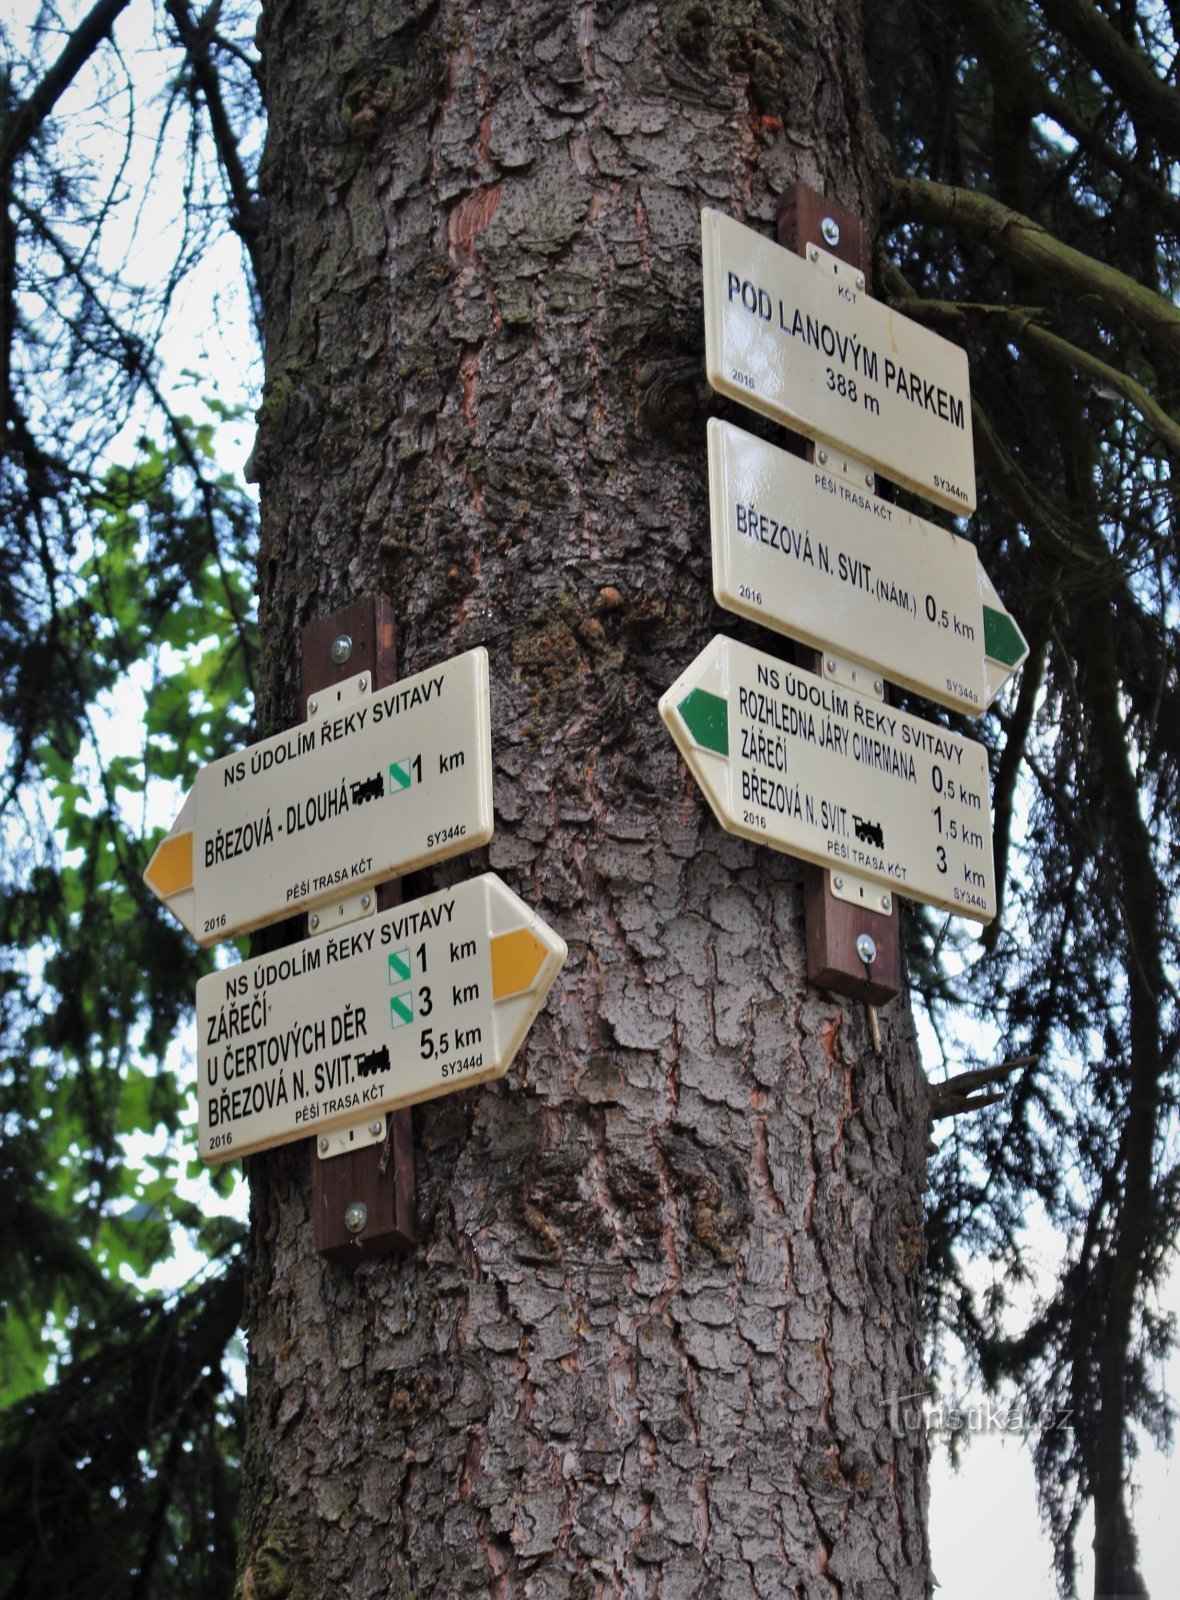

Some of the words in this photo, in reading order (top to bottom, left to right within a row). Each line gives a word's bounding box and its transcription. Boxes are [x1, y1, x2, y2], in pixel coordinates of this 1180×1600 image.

[838, 285, 857, 304] KČT
[727, 271, 772, 321] POD
[779, 300, 878, 382] LANOVÝM
[884, 358, 964, 429] PARKEM
[732, 370, 755, 389] 2016
[826, 368, 857, 403] 388
[864, 393, 880, 415] m
[815, 474, 837, 494] PĚŠÍ
[838, 485, 871, 512] TRASA
[873, 503, 892, 522] KČT
[933, 474, 968, 501] SY344m
[736, 504, 814, 566] BŘEZOVÁ
[818, 543, 833, 575] N.
[925, 595, 949, 628] 0,5
[953, 615, 974, 640] km
[739, 584, 762, 604] 2016
[946, 679, 978, 703] SY344a
[224, 762, 246, 787] NS
[251, 732, 316, 775] ÚDOLÍM
[320, 710, 368, 747] ŘEKY
[372, 675, 445, 723] SVITAVY
[758, 664, 779, 689] NS
[786, 672, 848, 716] ÚDOLÍM
[854, 700, 896, 737] ŘEKY
[901, 723, 963, 765] SVITAVY
[412, 754, 423, 784] 1
[439, 750, 465, 774] km
[739, 687, 815, 744] ROZHLEDNA
[819, 715, 849, 750] JÁRY
[853, 732, 916, 783] CIMRMANA
[932, 765, 955, 799] 0,5
[960, 785, 981, 808] km
[741, 726, 788, 773] ZÁŘEČÍ
[933, 806, 958, 839] 1,5
[962, 825, 984, 849] km
[427, 825, 466, 848] SY344c
[742, 770, 801, 824] BŘEZOVÁ
[806, 794, 818, 824] N.
[822, 801, 850, 838] SVIT.
[936, 846, 947, 873] 3
[964, 865, 986, 888] km
[743, 810, 766, 829] 2016
[286, 879, 311, 901] PĚŠÍ
[313, 869, 349, 893] TRASA
[351, 858, 373, 879] KČT
[827, 840, 850, 860] PĚŠÍ
[852, 849, 885, 872] TRASA
[888, 863, 907, 880] KČT
[954, 887, 987, 910] SY344b
[204, 914, 226, 933] 2016
[380, 900, 455, 945] SVITAVY
[326, 929, 375, 968] ŘEKY
[416, 943, 428, 973] 1
[449, 939, 477, 962] km
[226, 974, 248, 1000] NS
[254, 949, 321, 991] ÚDOLÍM
[207, 992, 268, 1045] ZÁŘEČÍ
[418, 986, 432, 1017] 3
[452, 983, 479, 1006] km
[207, 1059, 219, 1086] U
[223, 1019, 326, 1081] ČERTOVÝCH
[331, 1004, 367, 1047] DĚR
[420, 1028, 449, 1061] 5,5
[454, 1026, 482, 1053] km
[441, 1054, 483, 1078] SY344d
[208, 1068, 289, 1128] BŘEZOVÁ
[293, 1070, 309, 1098] N.
[314, 1054, 355, 1093] SVIT.
[295, 1104, 320, 1124] PĚŠÍ
[322, 1094, 360, 1118] TRASA
[362, 1084, 385, 1103] KČT
[209, 1132, 232, 1150] 2016
